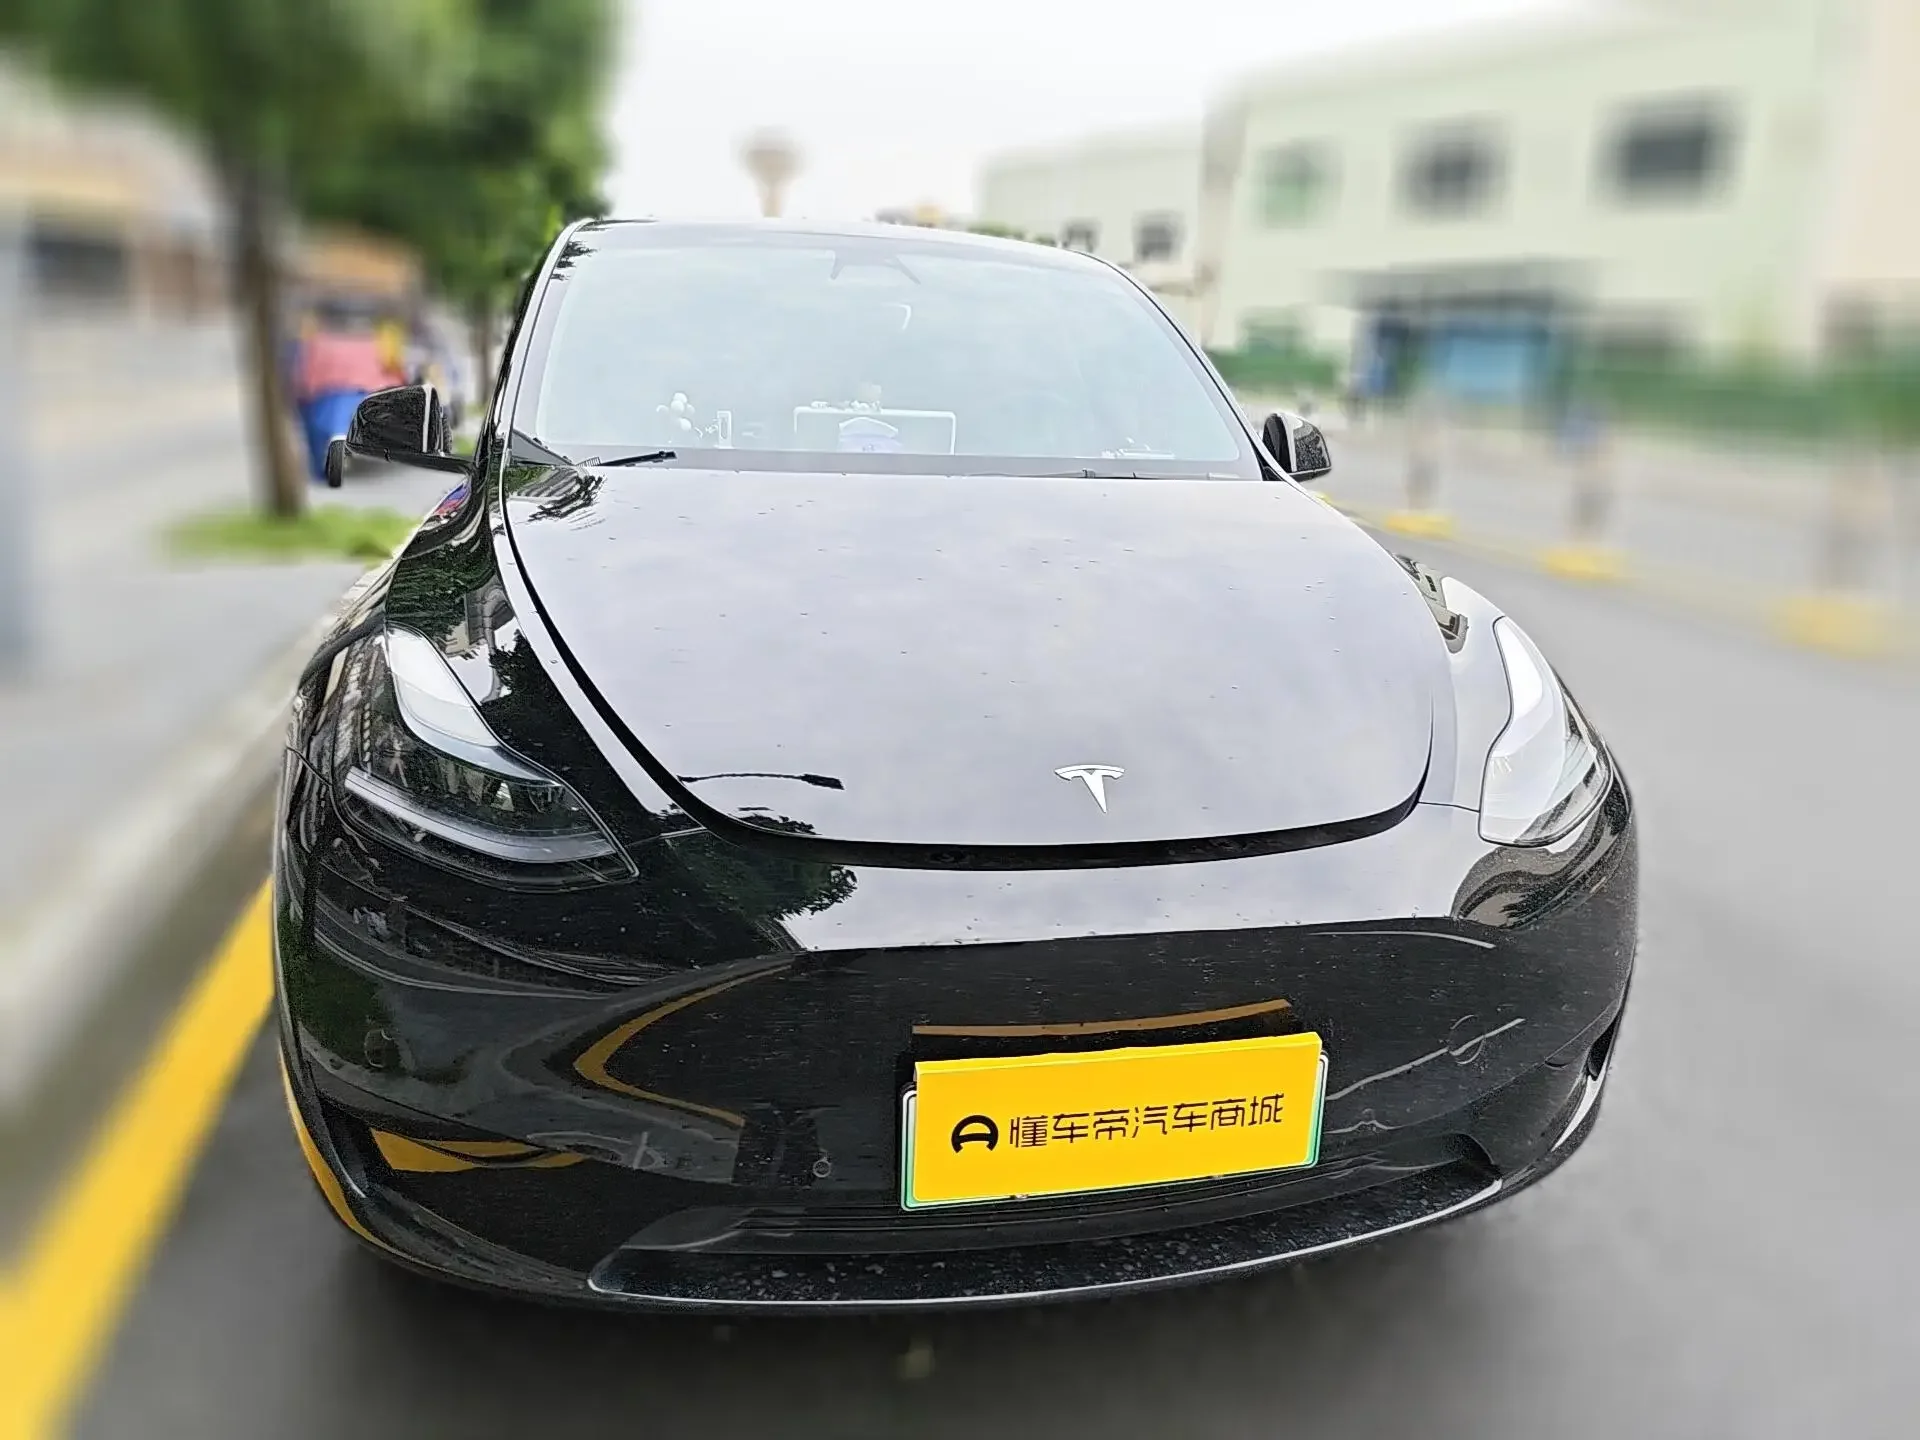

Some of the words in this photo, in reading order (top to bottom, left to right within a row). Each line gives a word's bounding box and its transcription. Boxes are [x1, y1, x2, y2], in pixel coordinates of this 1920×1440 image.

[1009, 1093, 1285, 1148] 懂车帝汽车商城
